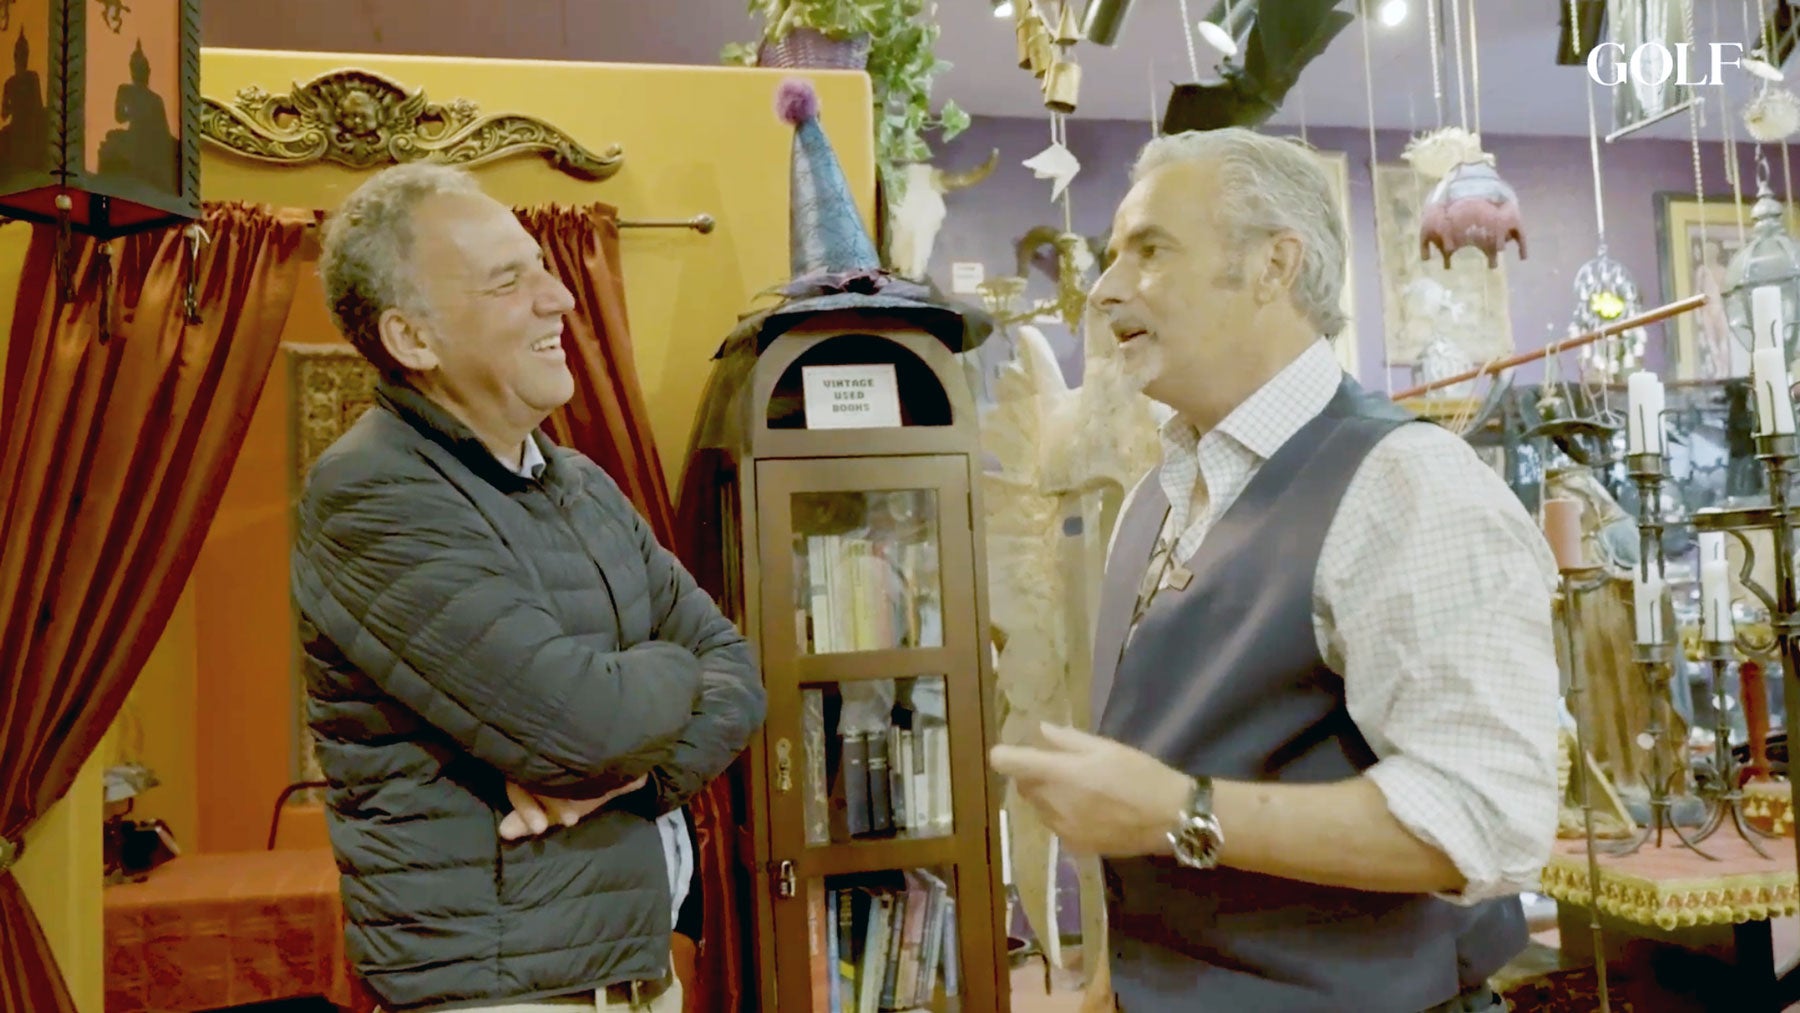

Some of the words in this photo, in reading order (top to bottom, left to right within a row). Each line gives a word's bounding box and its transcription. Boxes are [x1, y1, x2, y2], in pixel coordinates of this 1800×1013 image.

[823, 379, 874, 388] VINTAGE
[834, 391, 865, 400] USED
[832, 403, 870, 413] BOOKS
